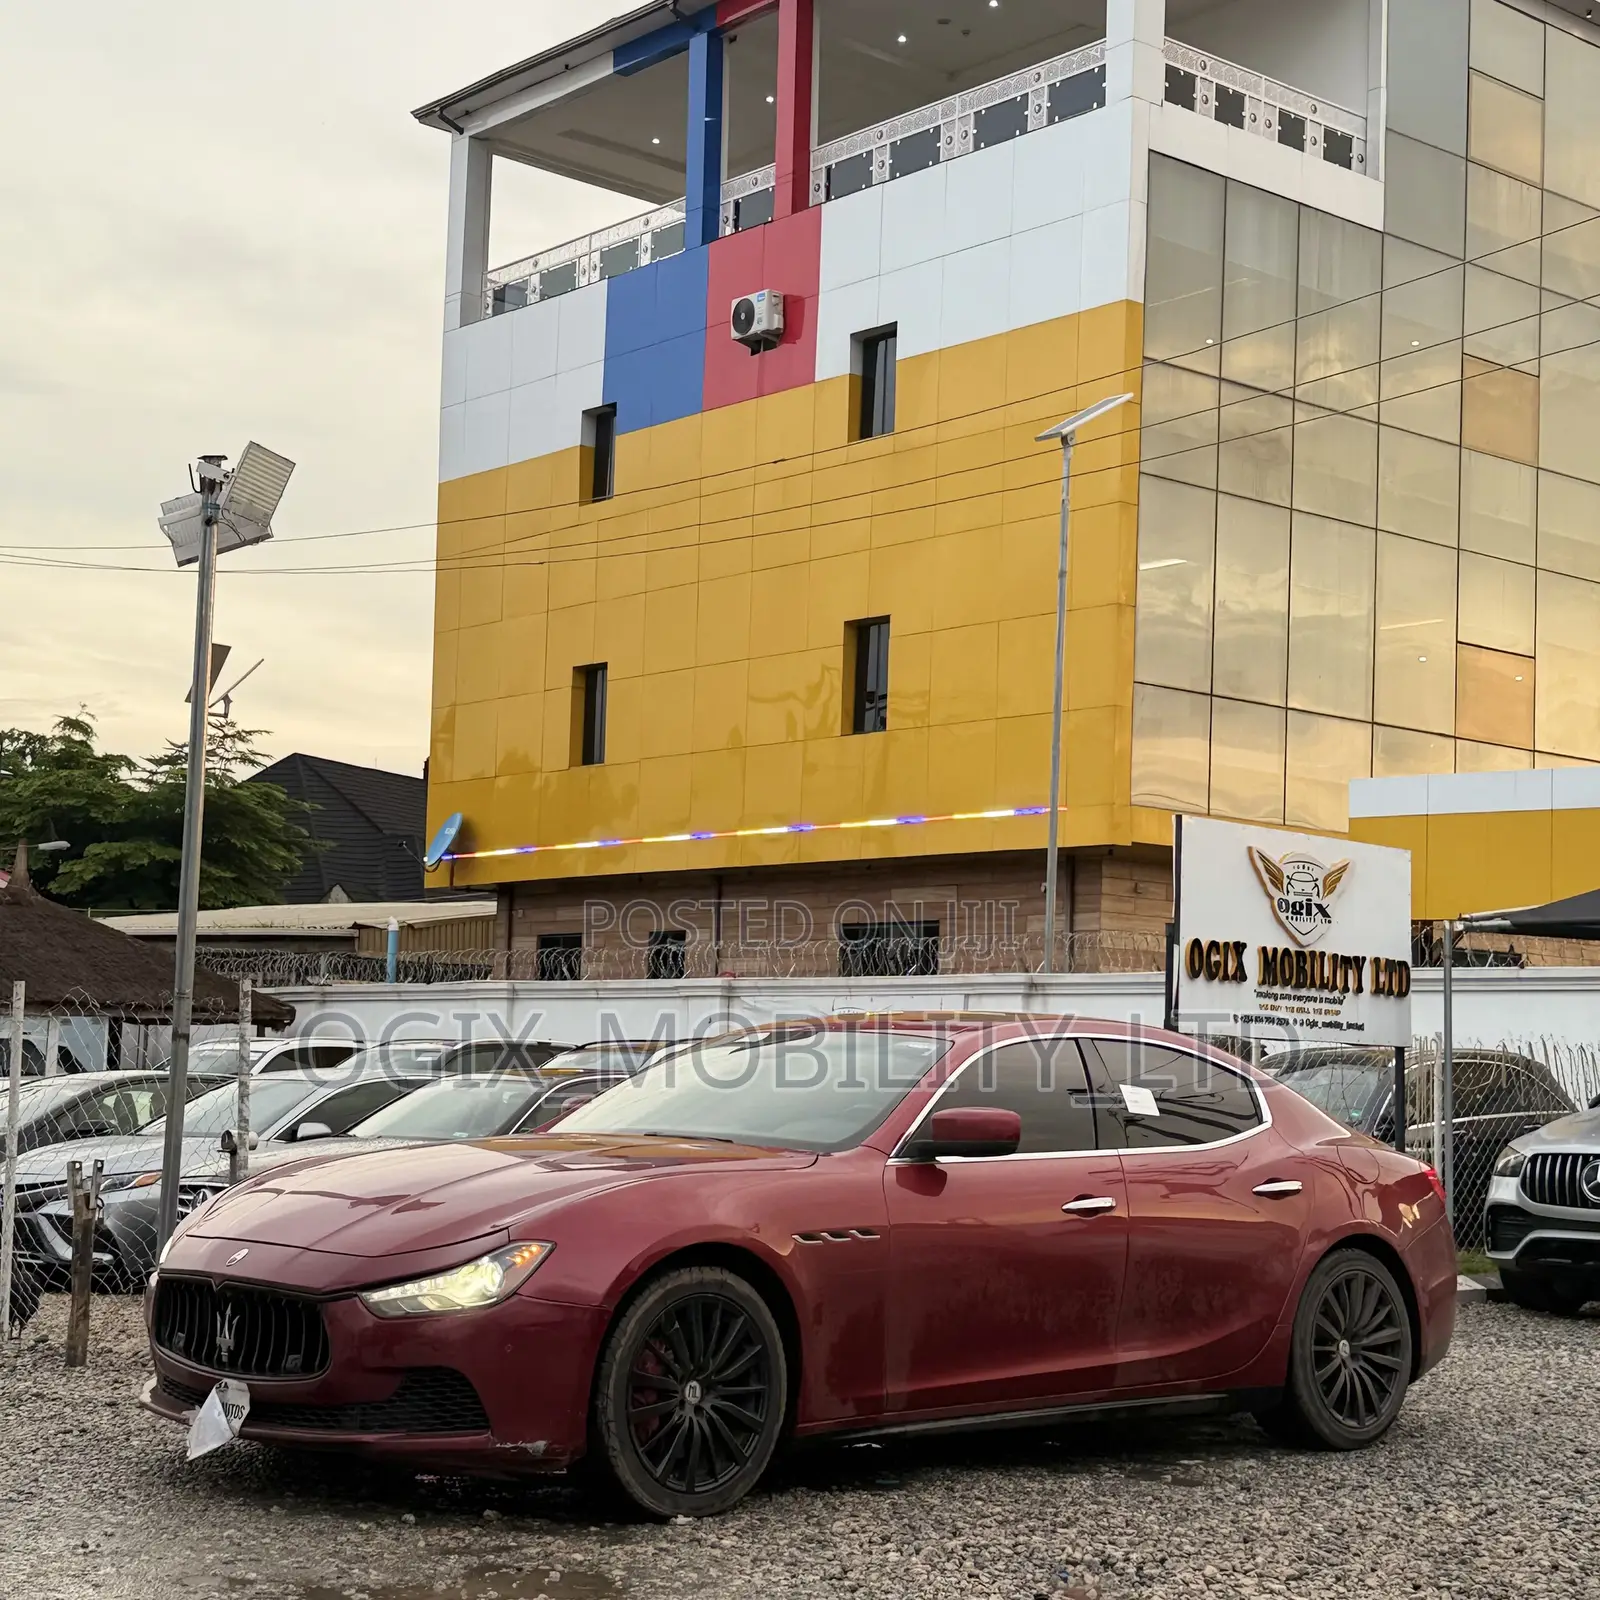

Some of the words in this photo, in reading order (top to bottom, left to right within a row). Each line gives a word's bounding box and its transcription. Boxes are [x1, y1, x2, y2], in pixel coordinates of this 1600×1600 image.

[1277, 898, 1332, 919] ogix
[1185, 937, 1248, 983] OGIX
[1257, 946, 1366, 994] MOBILITY
[1369, 956, 1411, 998] LTD
